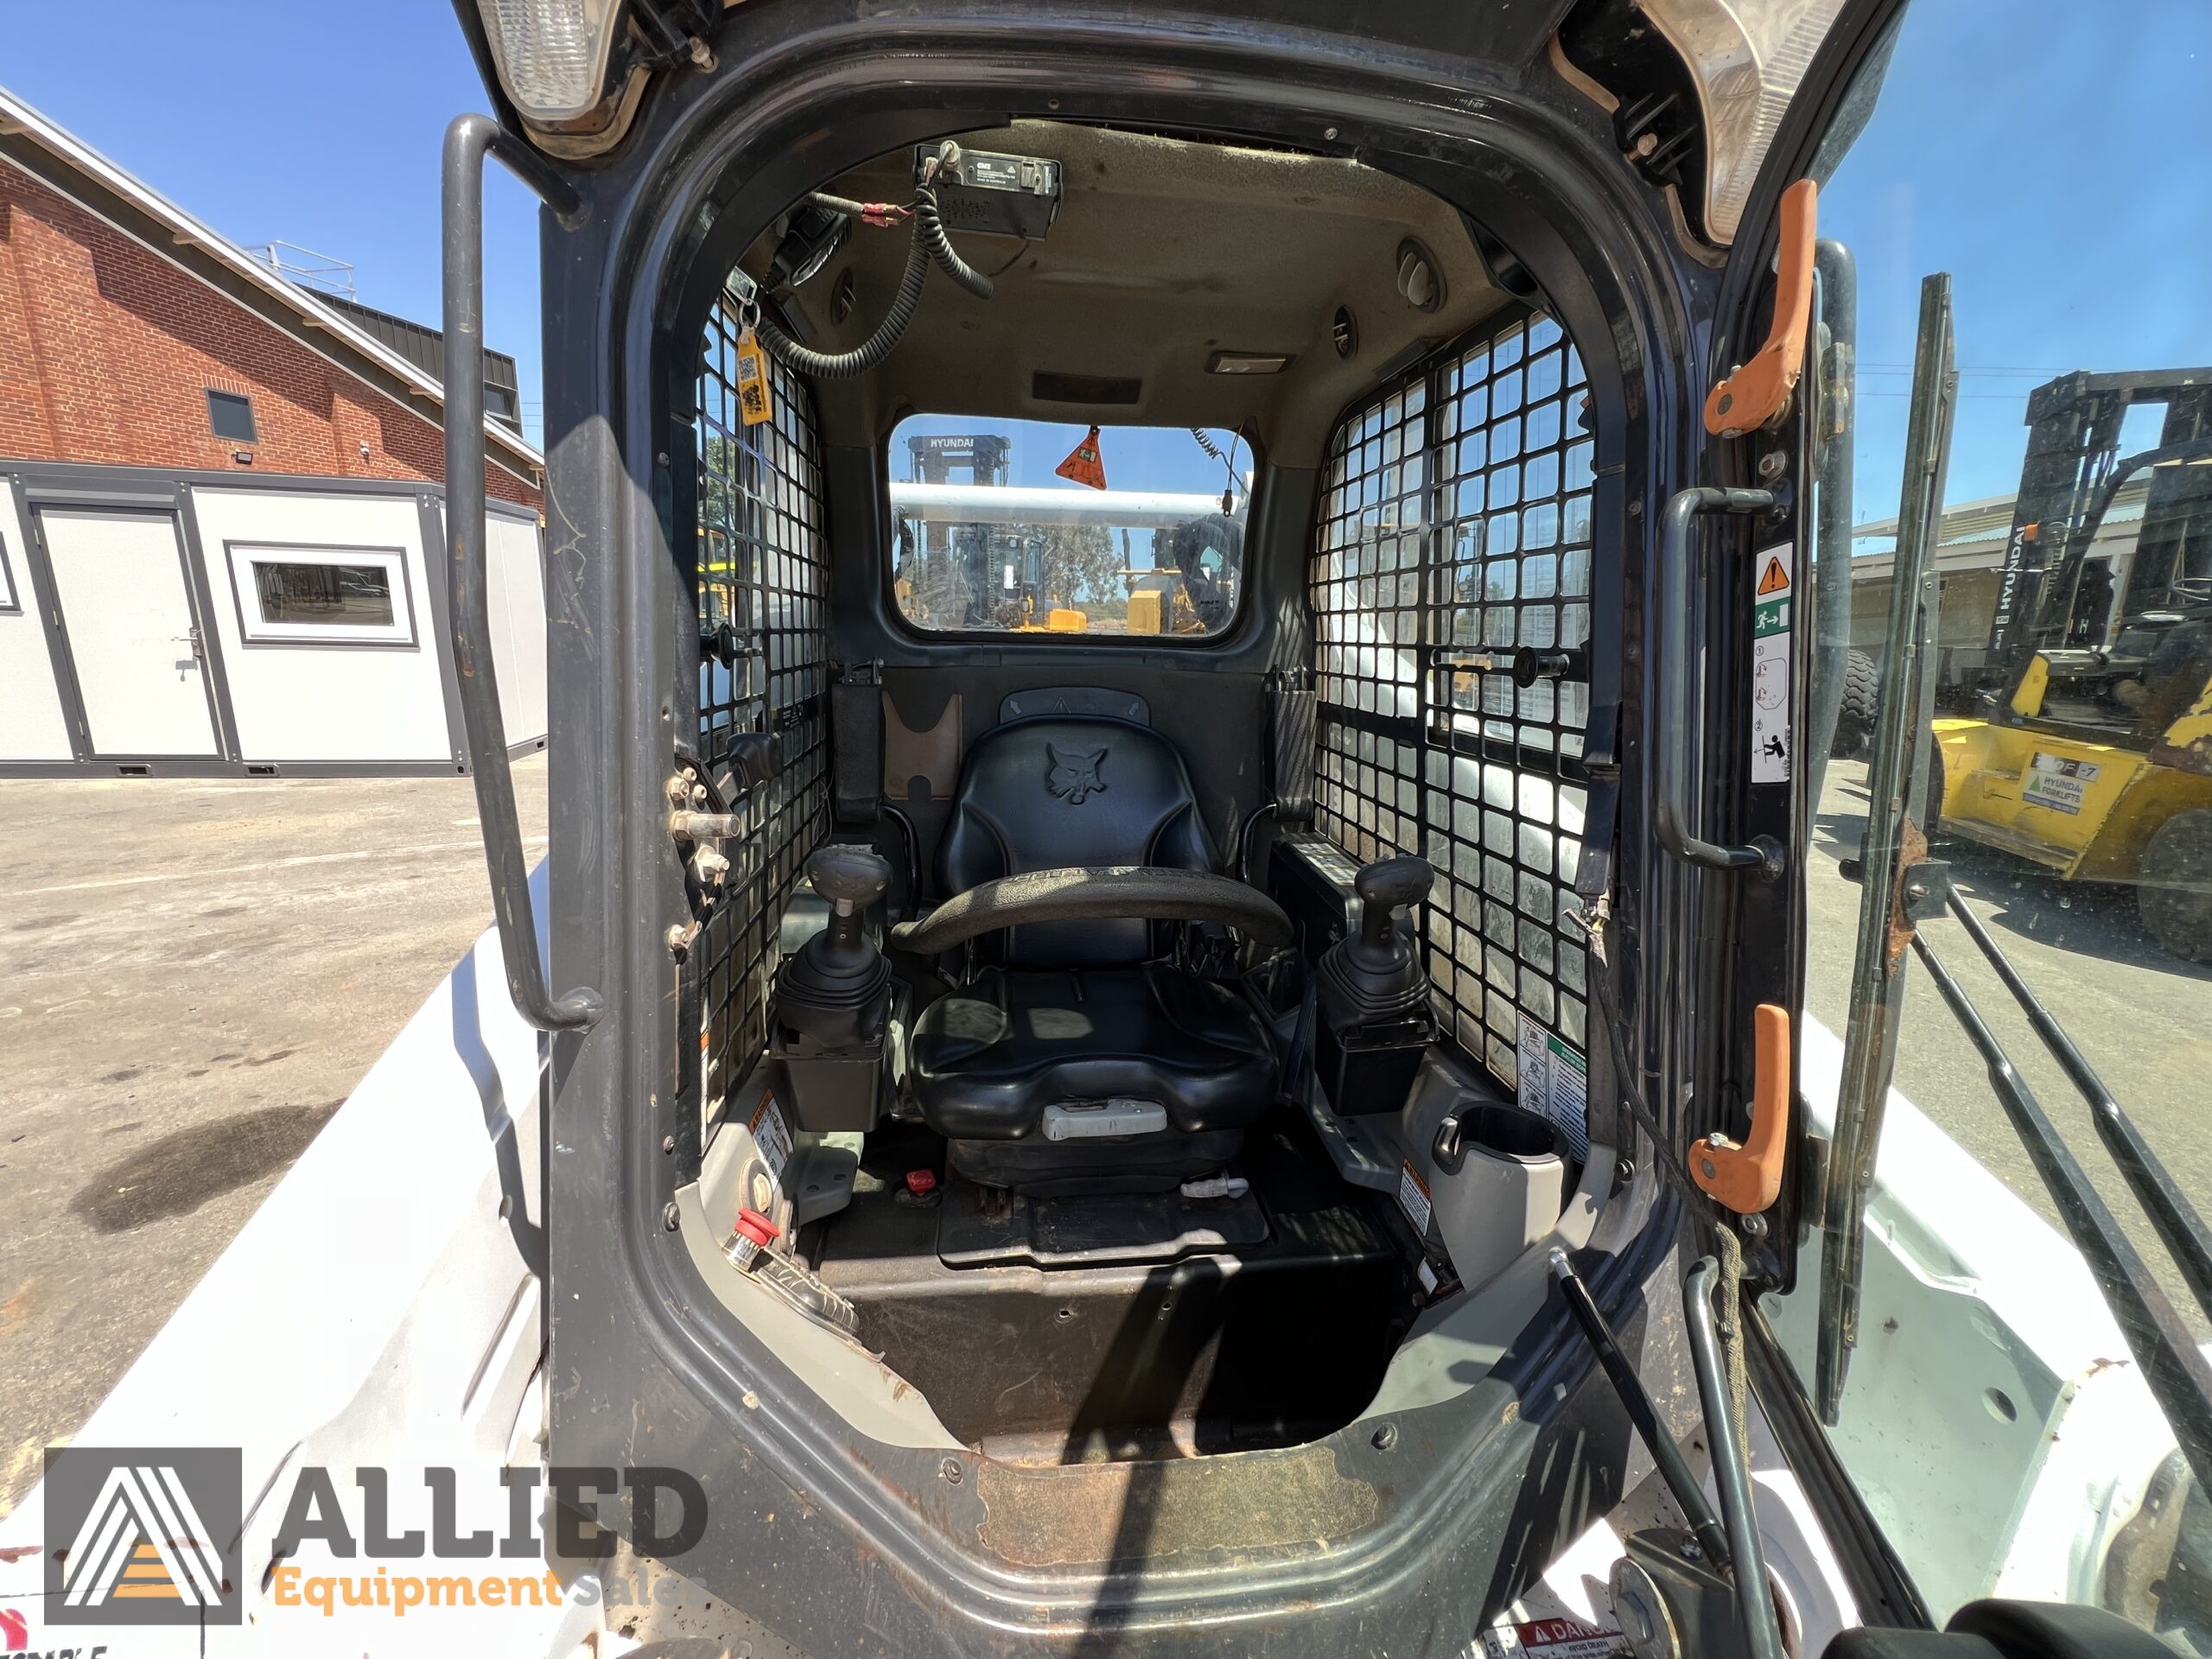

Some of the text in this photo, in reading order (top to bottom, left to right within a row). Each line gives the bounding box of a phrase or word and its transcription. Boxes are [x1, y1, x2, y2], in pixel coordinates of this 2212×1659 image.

[931, 438, 974, 448] HYUNDAI
[2000, 526, 2025, 610] HYUNDAI
[2044, 777, 2082, 793] HYUNDAI
[2042, 786, 2080, 804] FORKLIFTS
